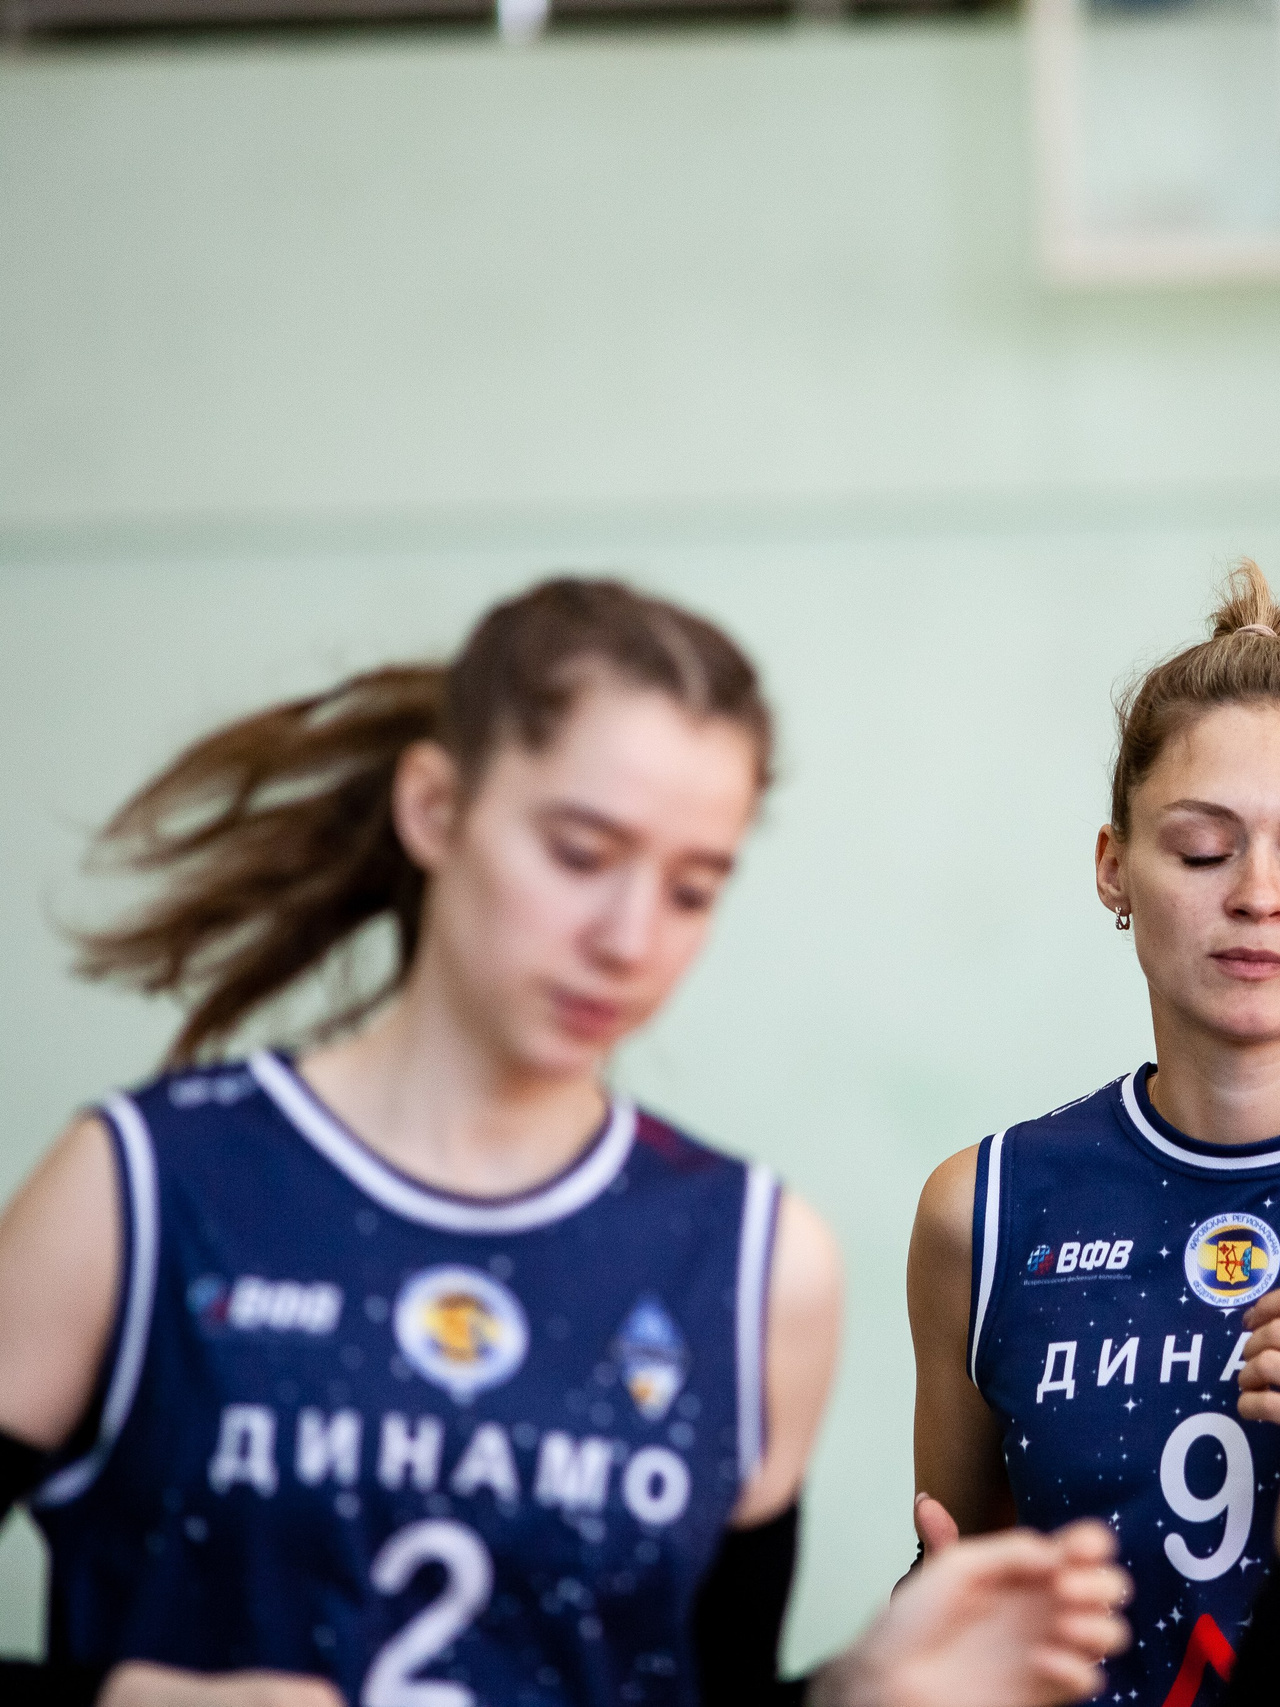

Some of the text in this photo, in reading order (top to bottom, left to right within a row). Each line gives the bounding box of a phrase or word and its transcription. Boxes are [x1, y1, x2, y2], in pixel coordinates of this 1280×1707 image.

[1056, 1240, 1134, 1273] ВФВ
[1036, 1331, 1254, 1404] ДИНА
[208, 1404, 690, 1524] ДИНАМО
[1160, 1412, 1255, 1582] 9
[361, 1519, 494, 1707] 2
